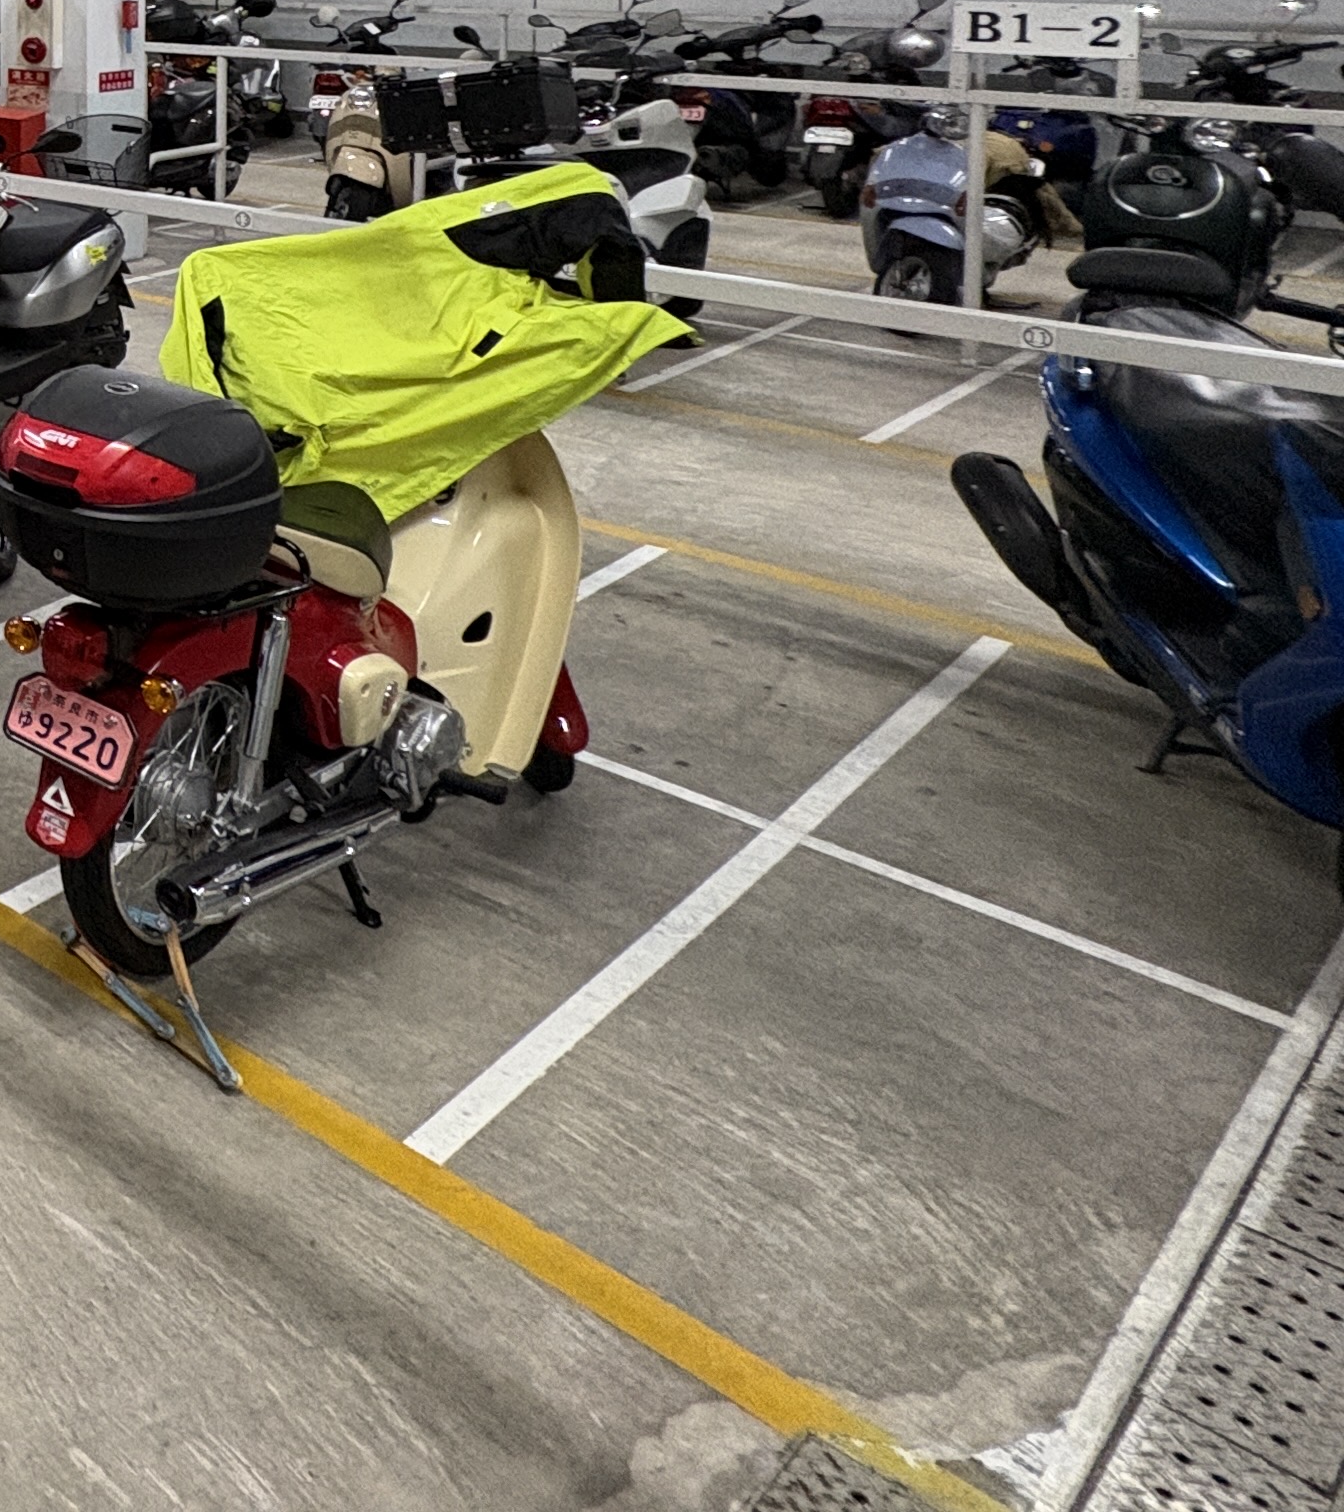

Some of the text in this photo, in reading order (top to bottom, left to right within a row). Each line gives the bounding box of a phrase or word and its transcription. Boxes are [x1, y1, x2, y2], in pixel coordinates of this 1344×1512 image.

[966, 10, 1121, 48] B1-2
[52, 693, 100, 725] 奈良市
[34, 713, 120, 771] 9220
